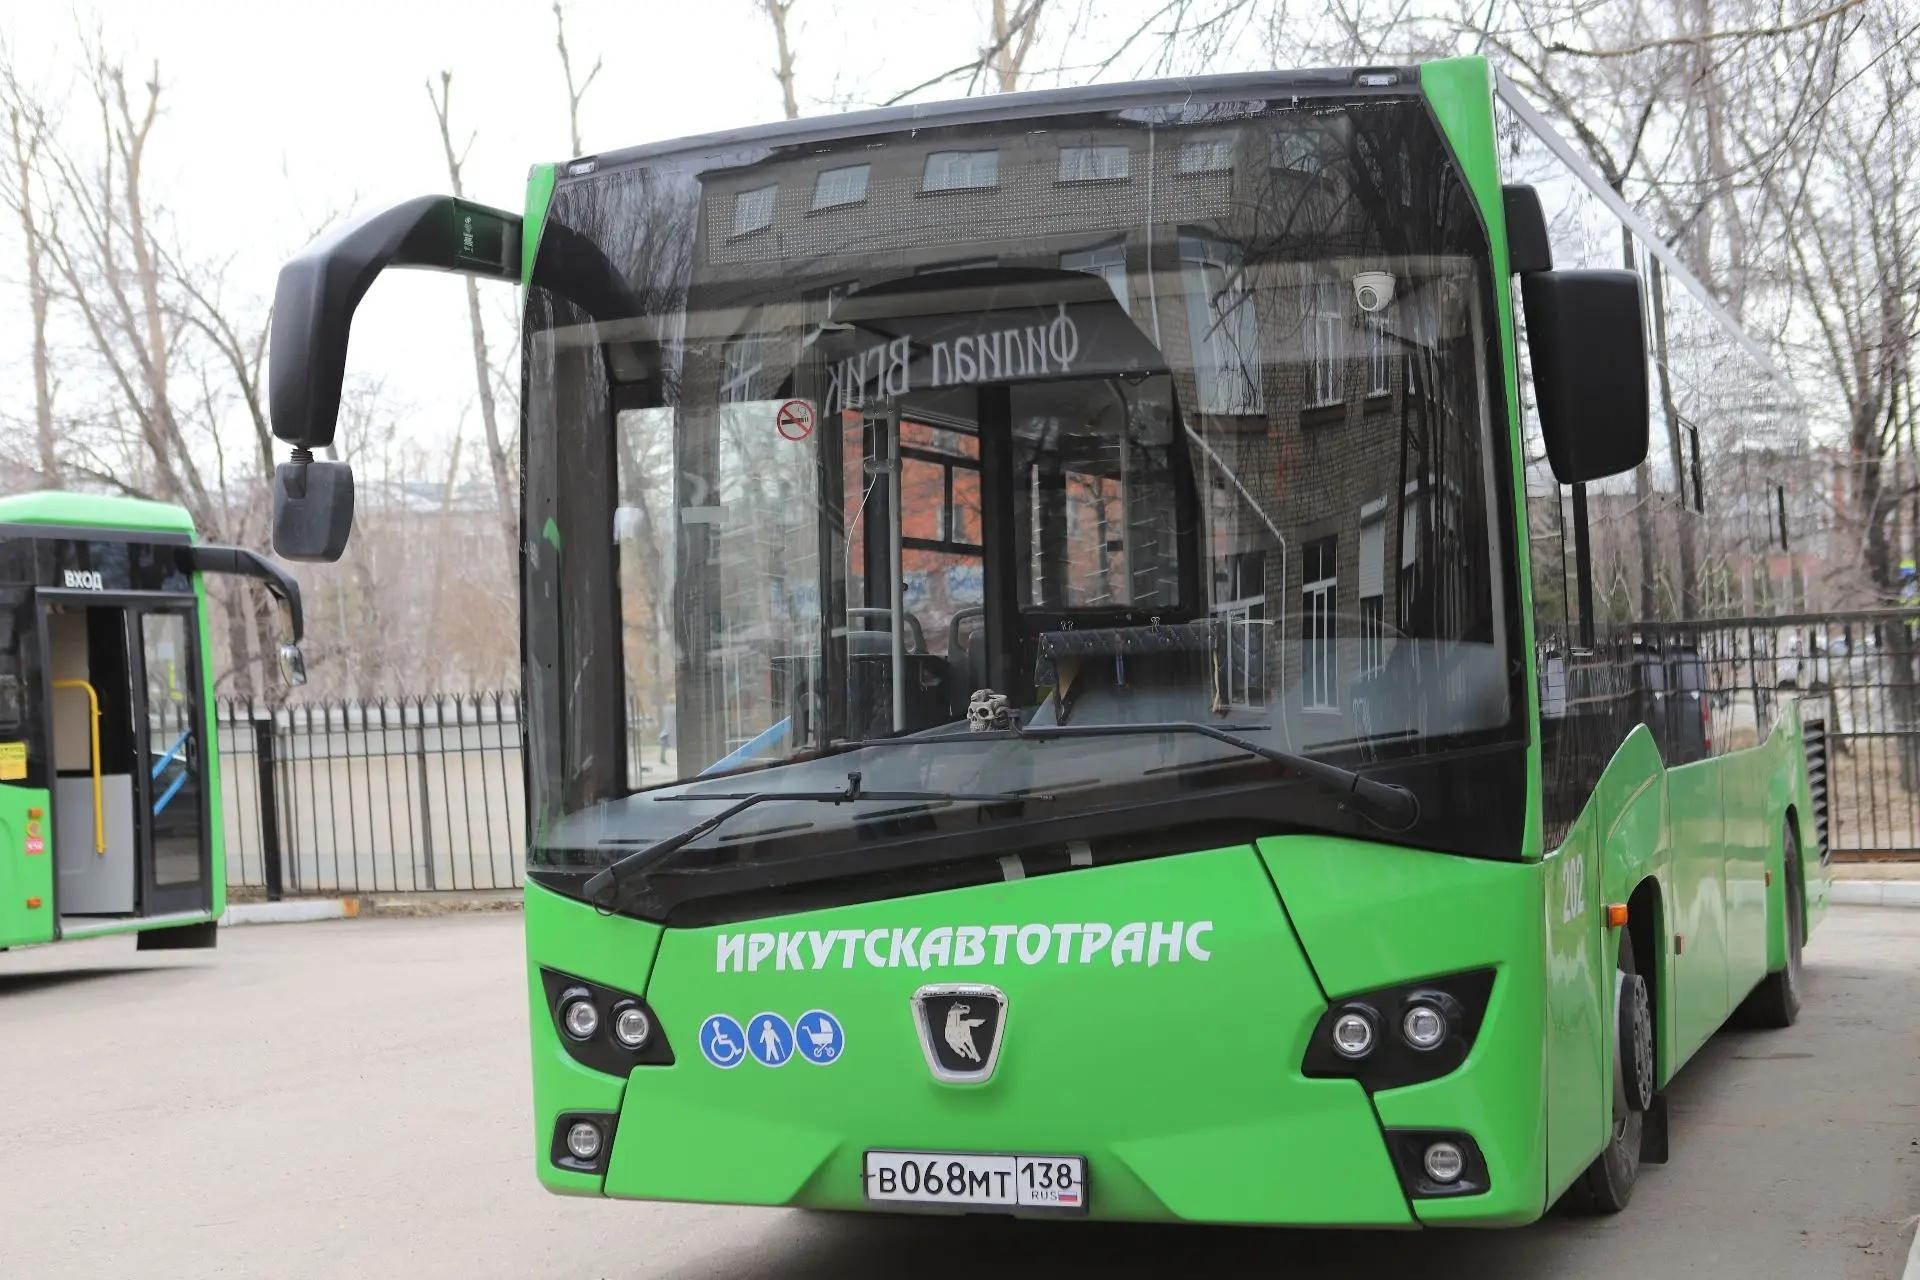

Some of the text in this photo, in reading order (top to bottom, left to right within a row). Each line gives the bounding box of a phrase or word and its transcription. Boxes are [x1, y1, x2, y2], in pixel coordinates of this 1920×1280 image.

[64, 569, 104, 592] ВХОД
[1562, 854, 1585, 924] 202
[715, 921, 1214, 972] ИРКУТСКАВТОТРАНС
[1021, 1162, 1074, 1190] 138
[1031, 1191, 1058, 1201] RUS
